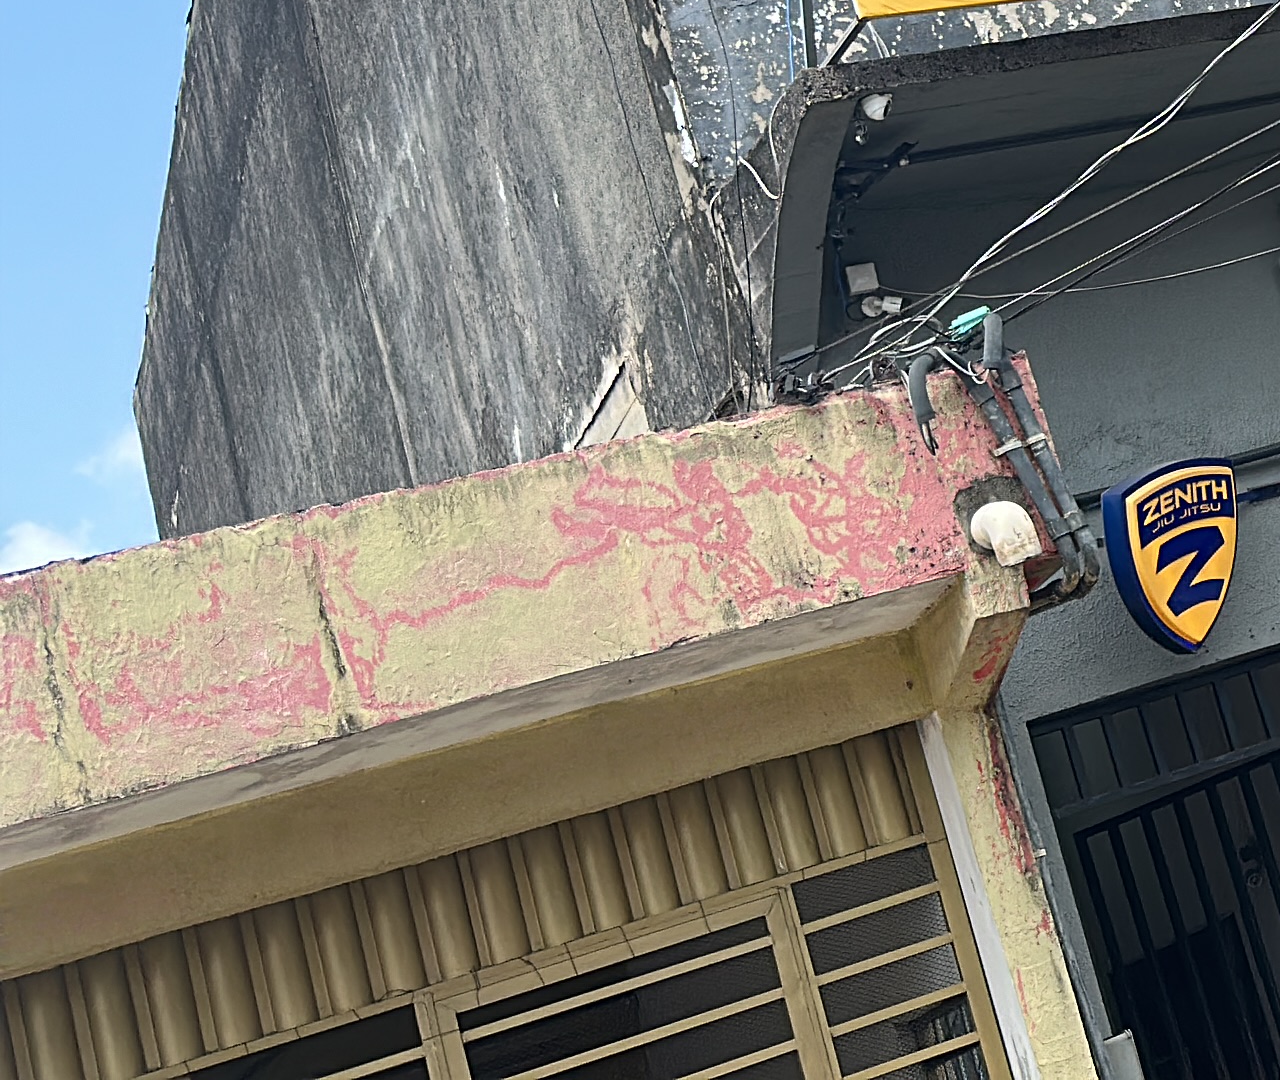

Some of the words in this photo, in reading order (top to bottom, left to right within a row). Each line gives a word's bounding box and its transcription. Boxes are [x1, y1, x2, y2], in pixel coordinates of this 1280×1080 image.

[1142, 479, 1229, 527] ZENITH
[1152, 515, 1175, 534] JIU
[1179, 502, 1222, 520] JITSU
[1155, 525, 1225, 617] Z
